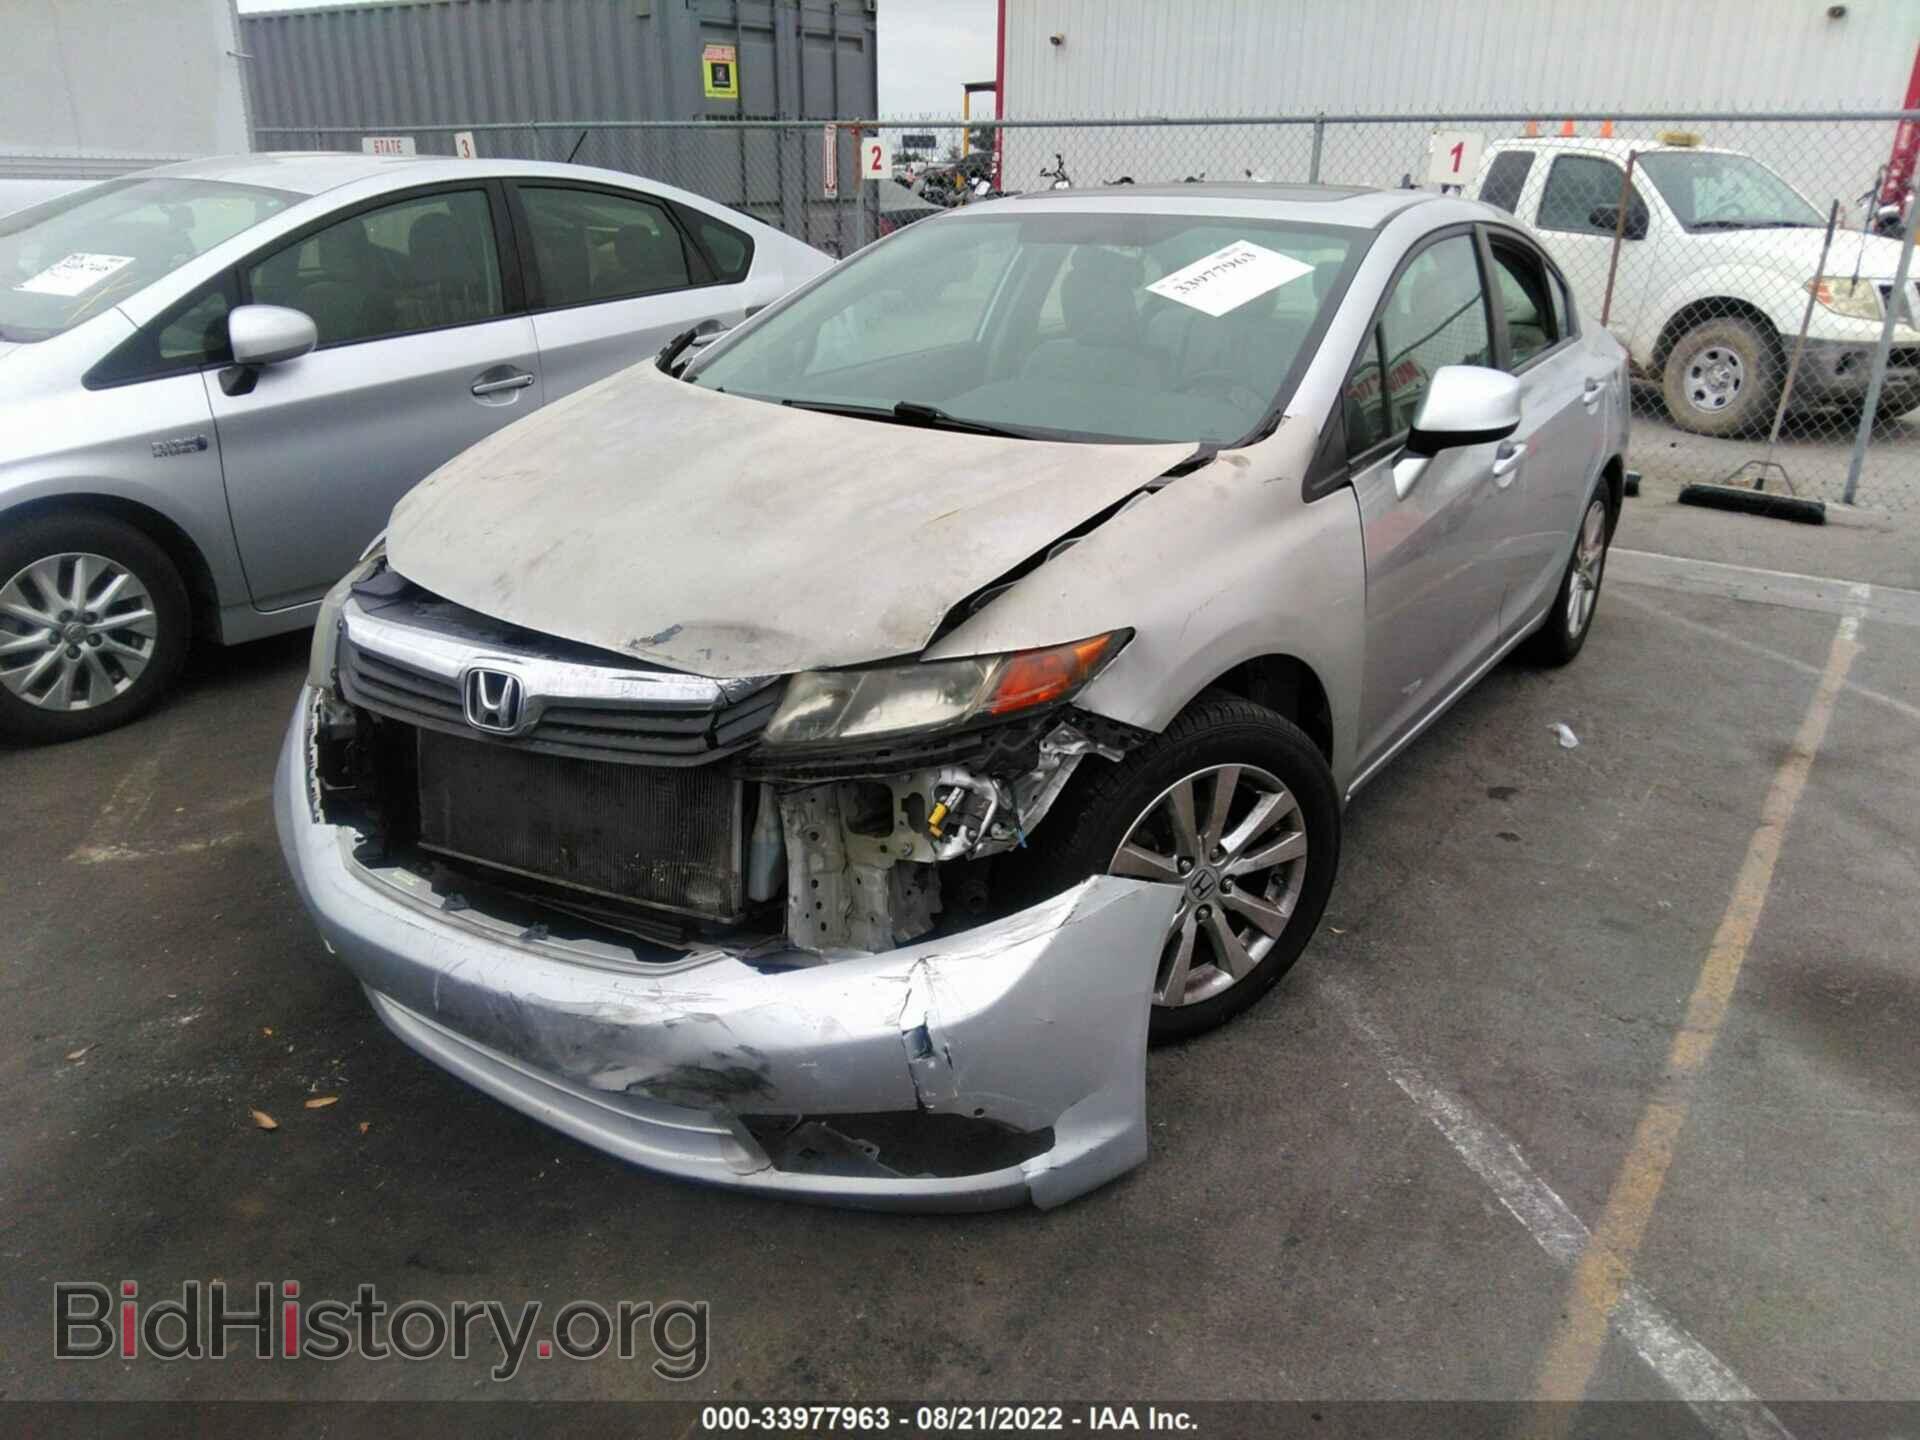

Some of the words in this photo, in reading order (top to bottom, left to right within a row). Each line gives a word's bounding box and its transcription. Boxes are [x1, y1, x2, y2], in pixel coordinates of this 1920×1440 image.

[373, 140, 402, 154] STATE
[462, 139, 470, 159] 3
[871, 145, 882, 170] 2
[1450, 141, 1464, 172] 1
[1174, 252, 1257, 294] 33977963
